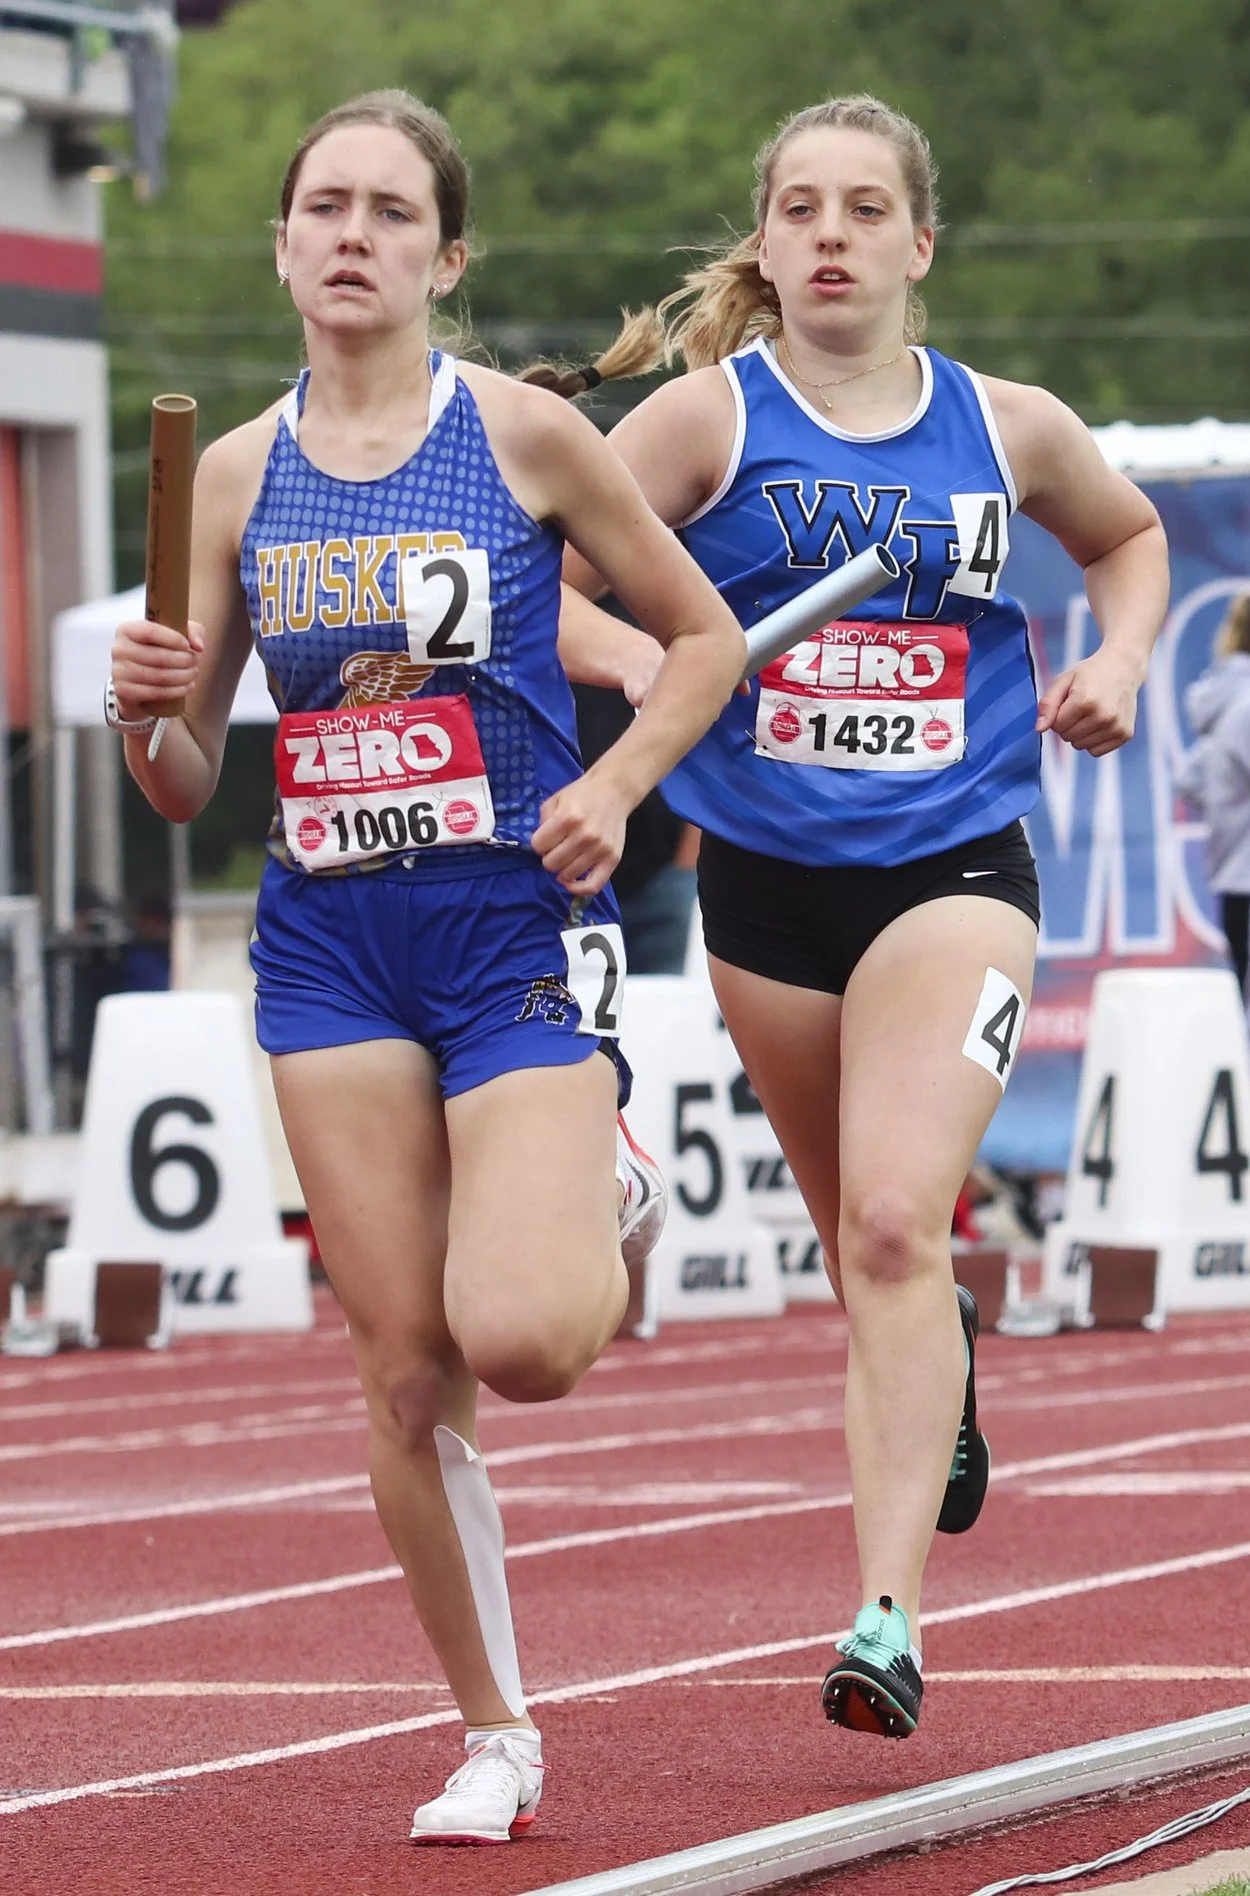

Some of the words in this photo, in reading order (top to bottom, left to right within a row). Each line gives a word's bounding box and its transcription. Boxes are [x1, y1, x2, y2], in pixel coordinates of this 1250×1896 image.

[968, 500, 1001, 592] 4
[421, 558, 475, 659] 2
[822, 629, 912, 646] SHOW-ME
[782, 641, 946, 688] ZERO
[285, 722, 453, 784] ZERO
[315, 709, 406, 735] SHOW-ME
[808, 713, 915, 756] 1432
[331, 801, 439, 853] 1006
[580, 932, 618, 1031] 2
[981, 993, 1020, 1077] 4
[130, 1095, 220, 1234] 6
[674, 1083, 725, 1217] 5
[1083, 1075, 1113, 1207] 4
[1197, 1069, 1250, 1202] 4
[681, 1255, 748, 1290] GILL
